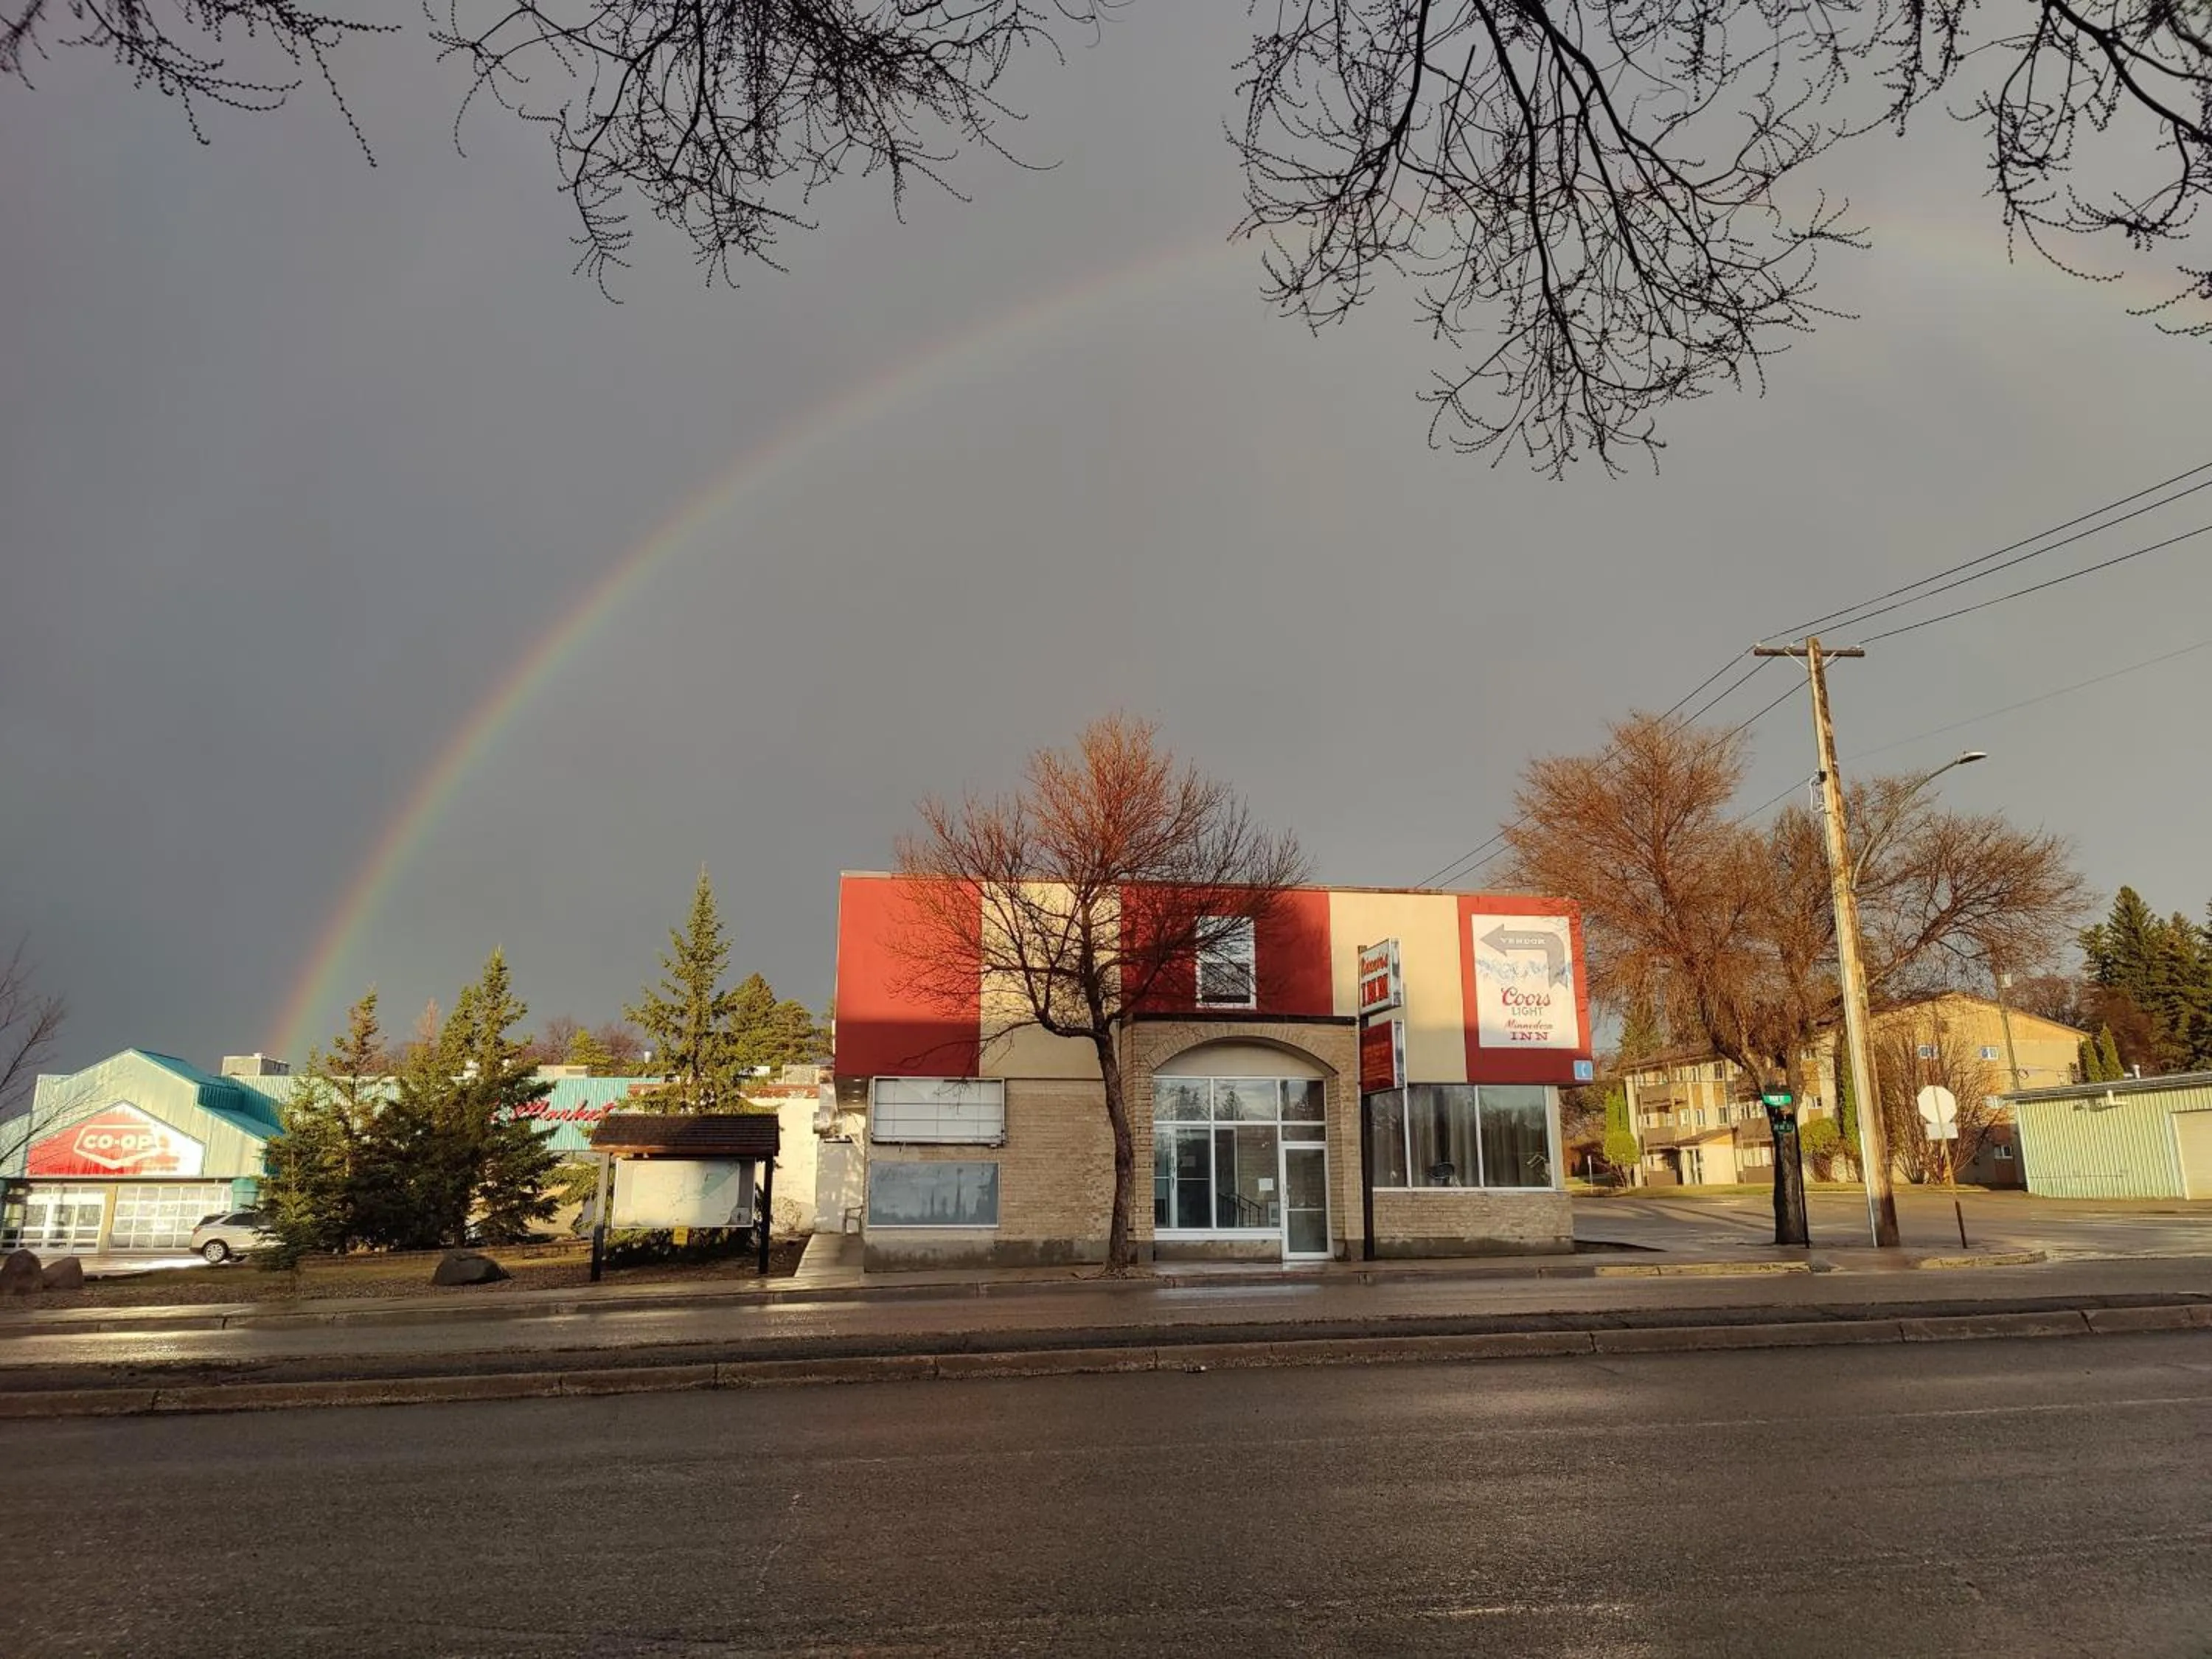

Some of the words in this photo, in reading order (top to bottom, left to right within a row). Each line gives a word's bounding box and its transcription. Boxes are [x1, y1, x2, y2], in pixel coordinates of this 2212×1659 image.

[1500, 986, 1551, 1006] Coors
[1512, 1006, 1543, 1016] LIGHT
[1510, 1032, 1548, 1040] INN
[83, 1134, 155, 1150] CO-OP
